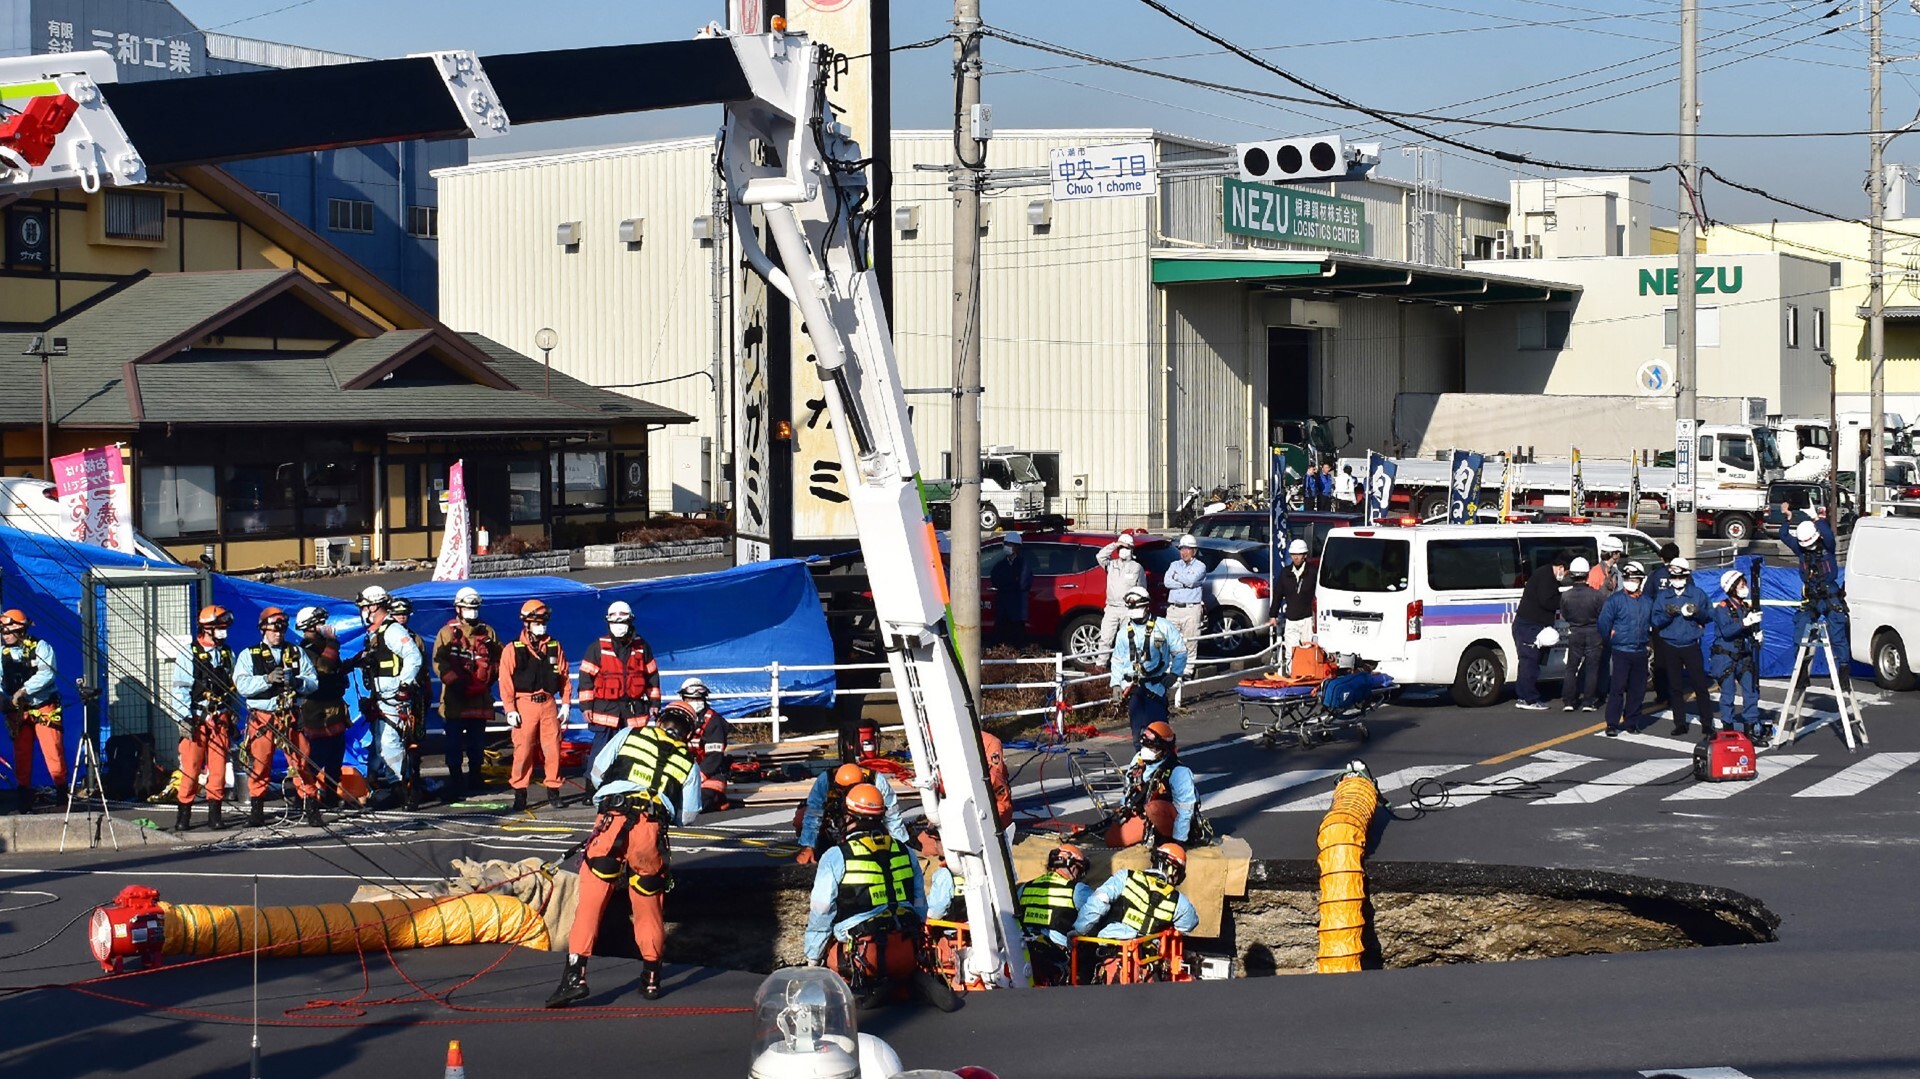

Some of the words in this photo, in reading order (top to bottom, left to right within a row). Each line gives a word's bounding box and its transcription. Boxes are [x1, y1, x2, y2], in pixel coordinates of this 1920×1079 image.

[91, 29, 191, 74] 三和工業
[1058, 154, 1146, 183] 中央一丁目
[1066, 182, 1094, 195] Chuo
[1106, 180, 1142, 193] chome
[1231, 186, 1289, 235] NEZU
[1293, 219, 1331, 241] LOGISTICS
[1332, 225, 1360, 244] CENTER
[1638, 265, 1743, 296] NEZU
